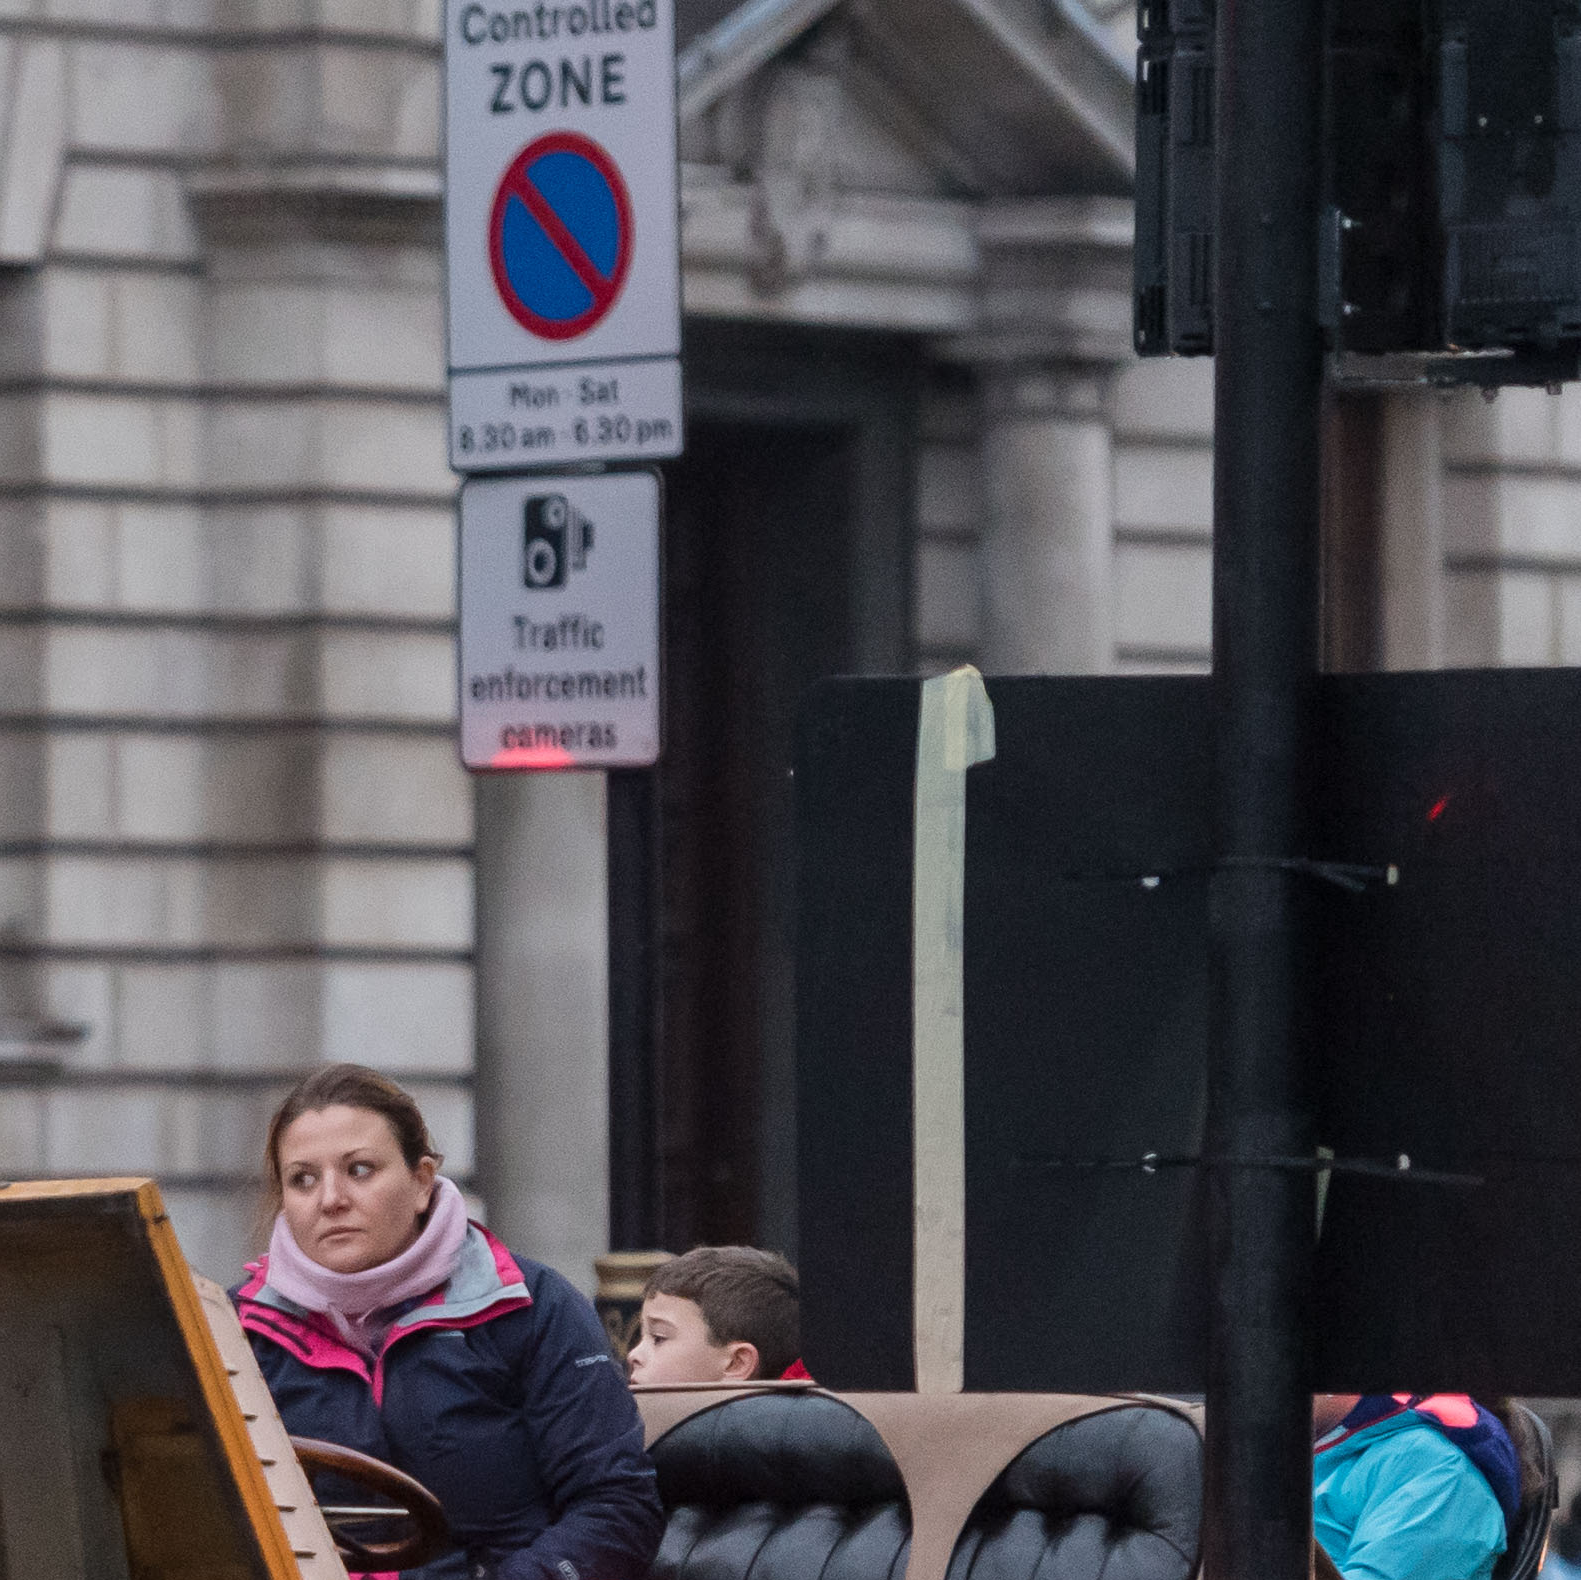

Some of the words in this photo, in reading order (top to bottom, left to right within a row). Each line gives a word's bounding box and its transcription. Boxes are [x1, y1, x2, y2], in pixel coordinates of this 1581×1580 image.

[460, 0, 657, 45] Controlled
[489, 52, 626, 114] ZONE
[509, 381, 559, 408] Mon
[579, 375, 618, 405] Sat
[512, 613, 605, 651] Traffic
[469, 664, 646, 702] enforcement
[500, 721, 617, 750] cameras
